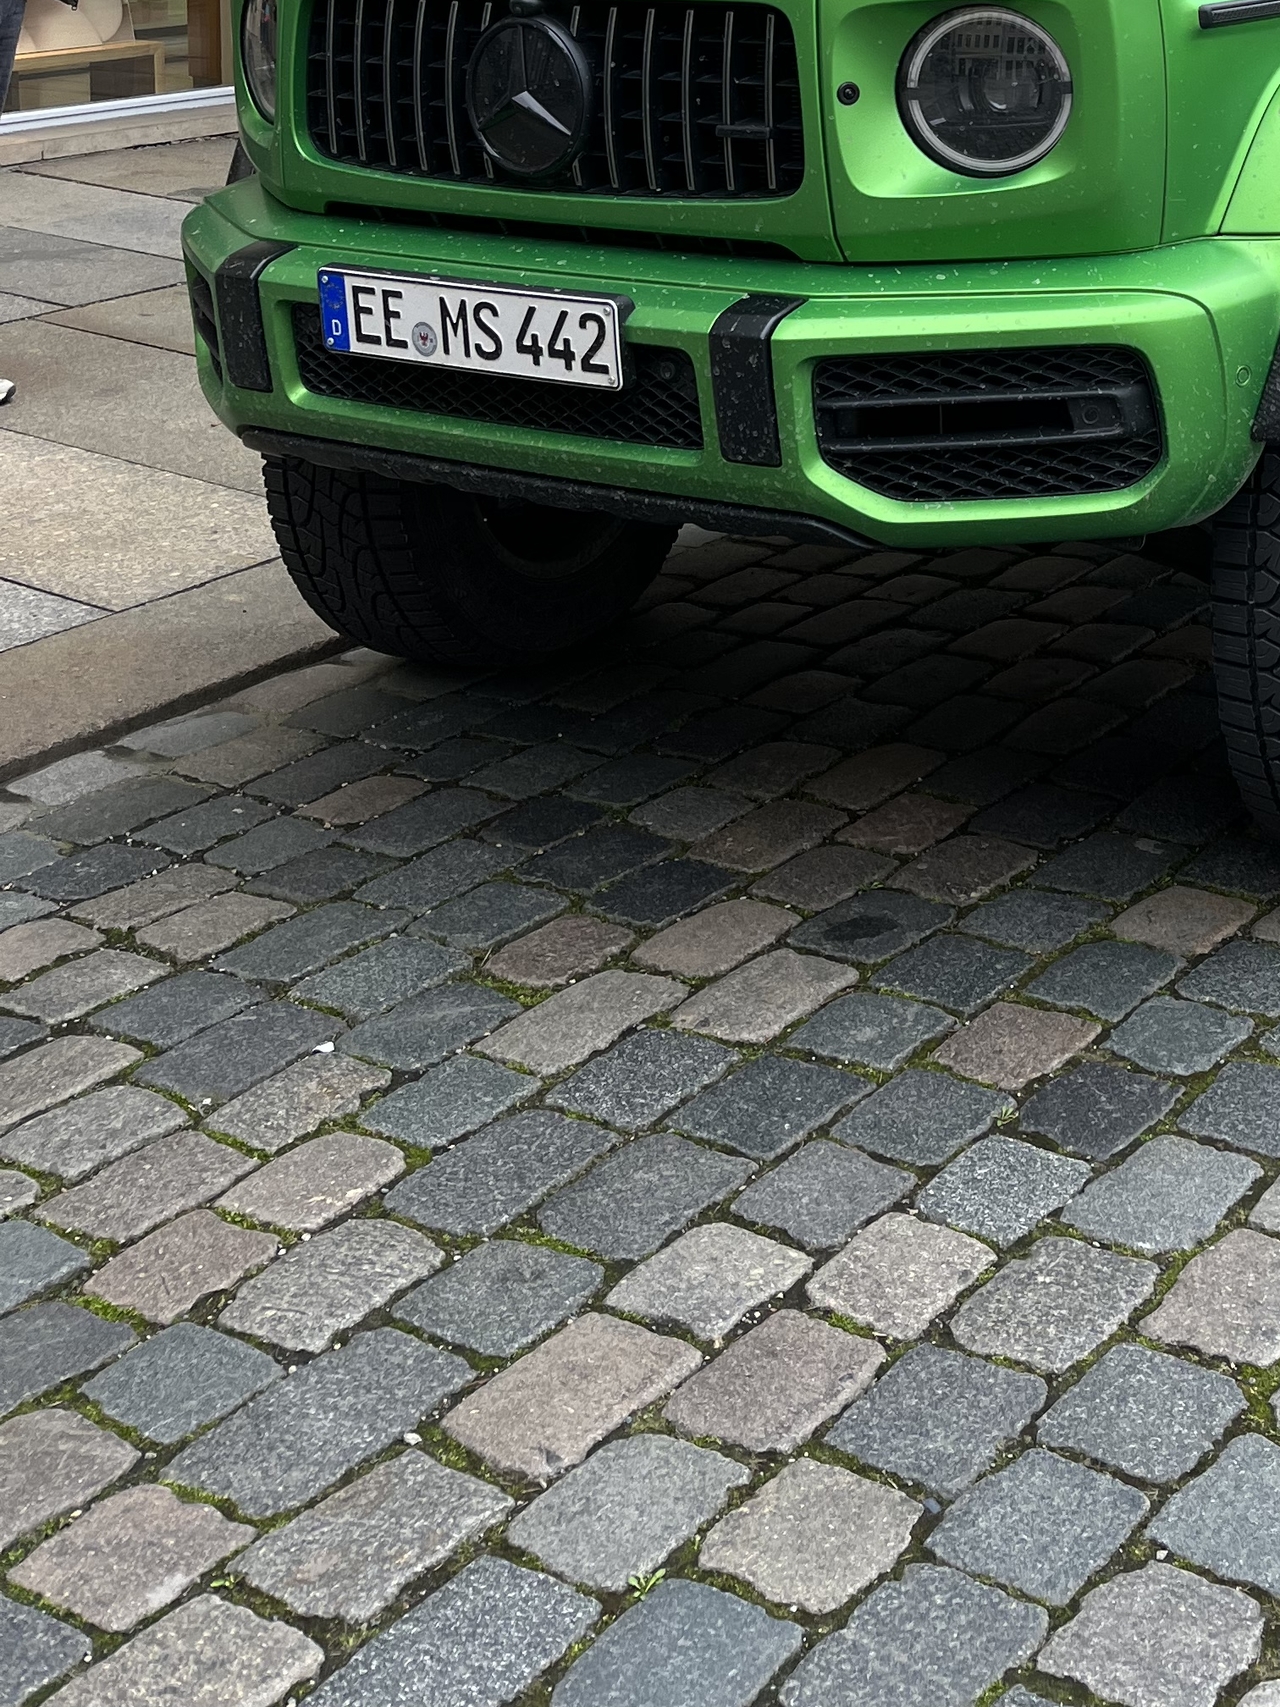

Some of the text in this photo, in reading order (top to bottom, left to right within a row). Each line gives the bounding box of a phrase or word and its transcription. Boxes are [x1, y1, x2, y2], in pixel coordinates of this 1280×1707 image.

[332, 319, 341, 336] D
[352, 284, 610, 374] EE MS 442
